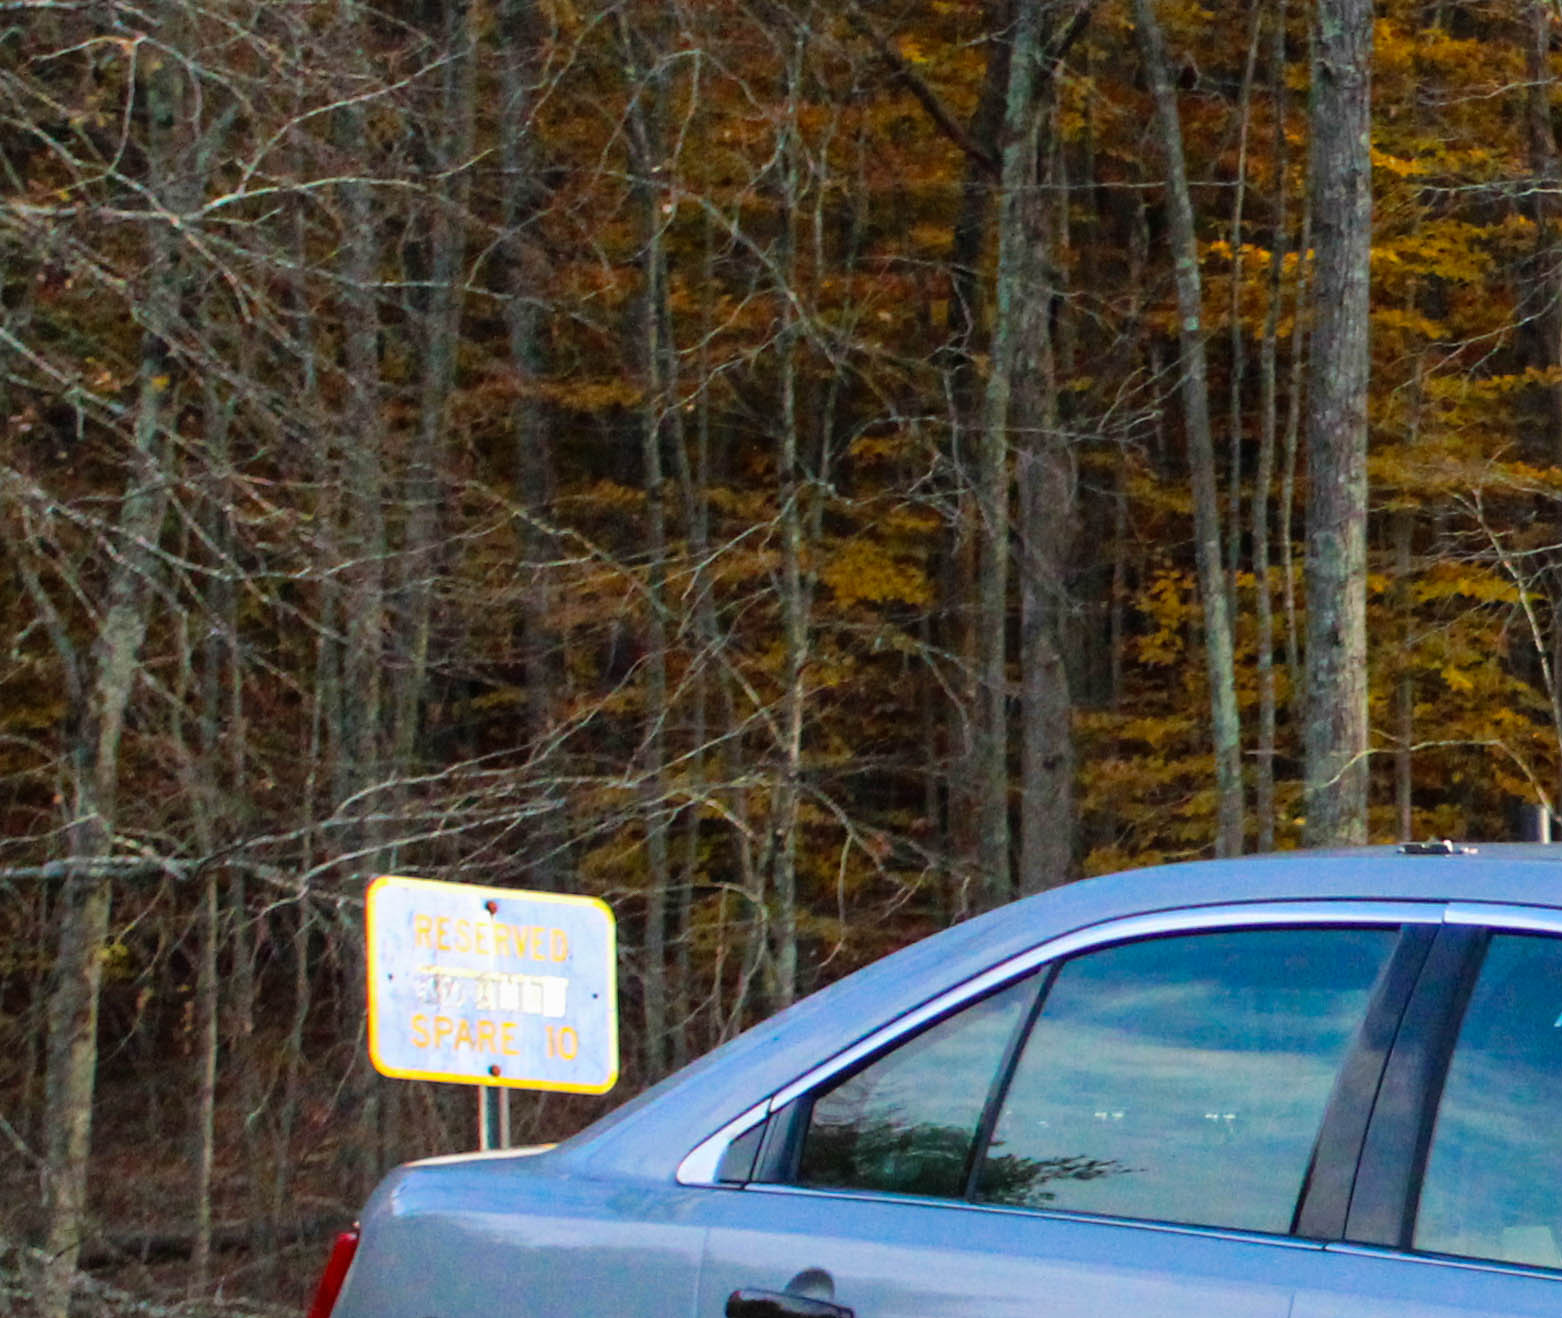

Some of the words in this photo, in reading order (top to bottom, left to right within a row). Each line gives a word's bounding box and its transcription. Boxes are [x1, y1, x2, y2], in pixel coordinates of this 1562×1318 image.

[414, 914, 569, 962] RESERVED
[411, 1013, 520, 1056] SPARE
[545, 1026, 579, 1061] 10
